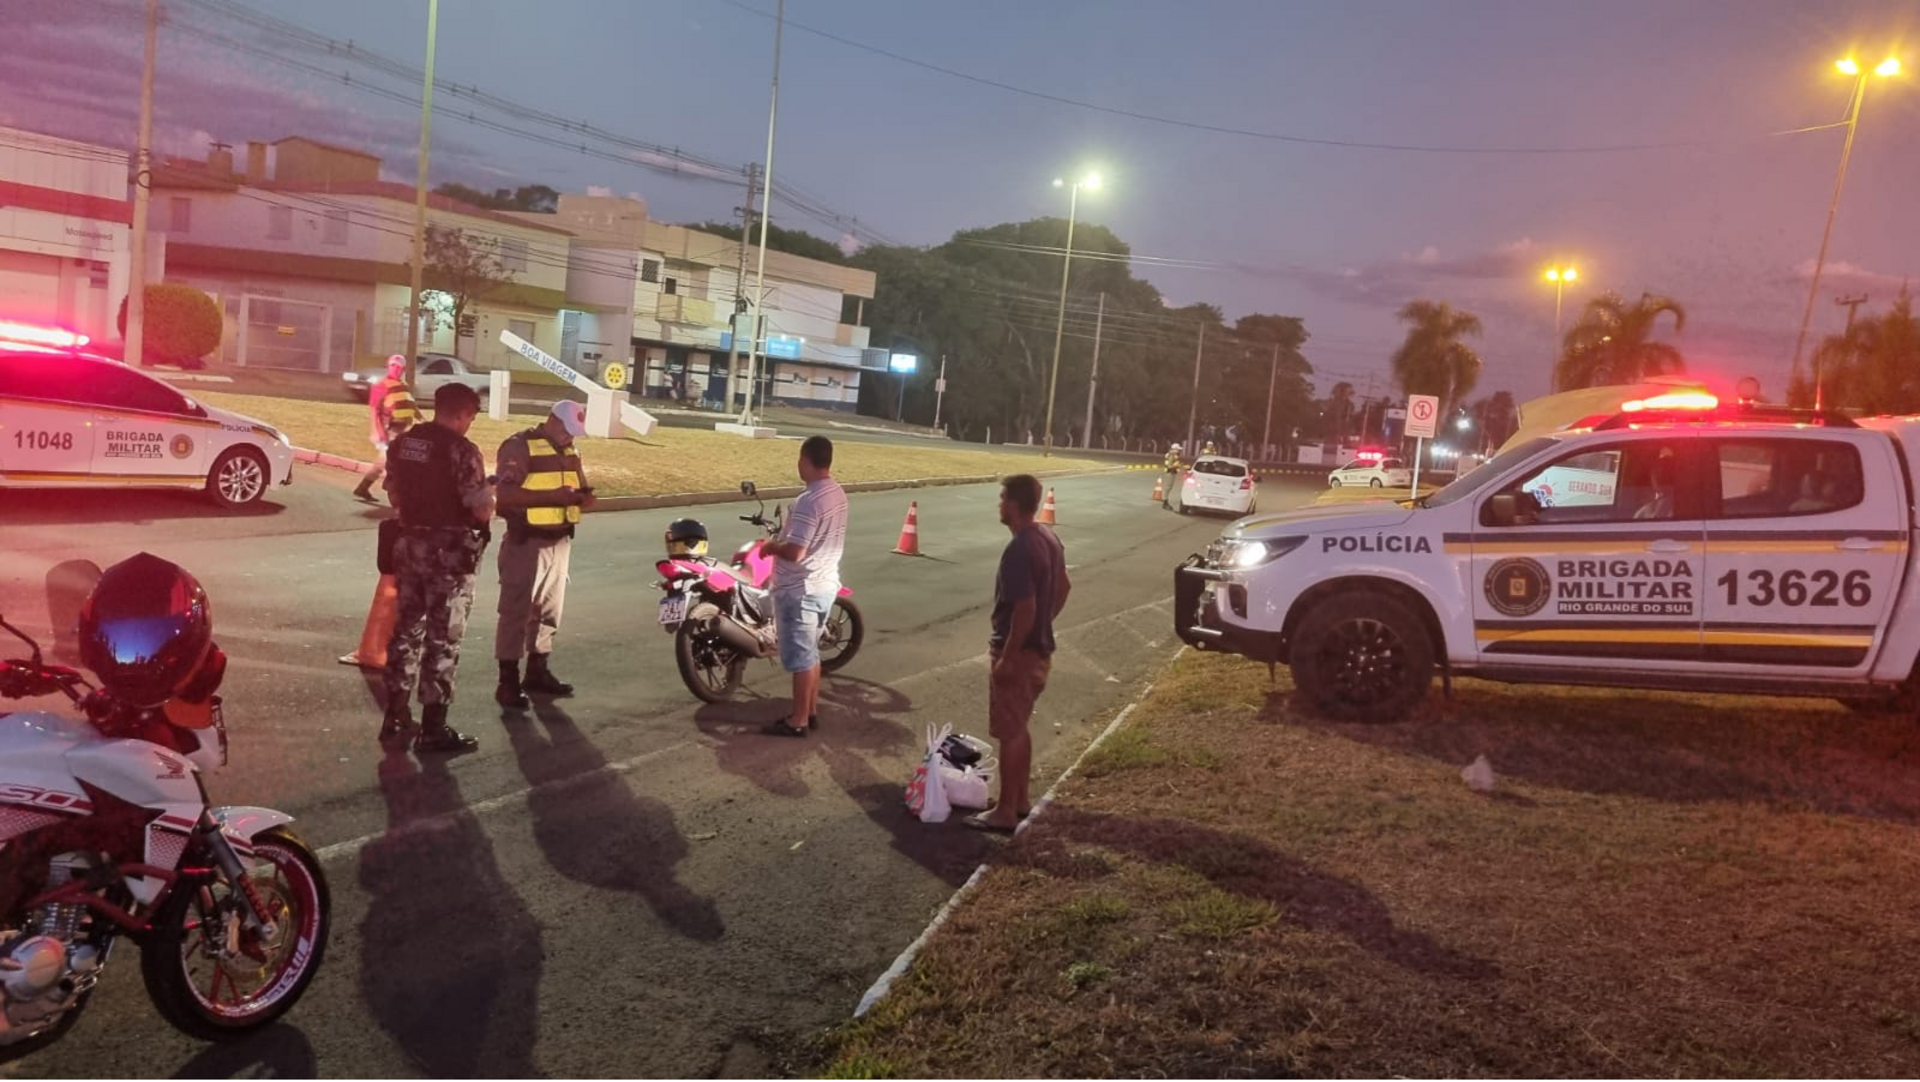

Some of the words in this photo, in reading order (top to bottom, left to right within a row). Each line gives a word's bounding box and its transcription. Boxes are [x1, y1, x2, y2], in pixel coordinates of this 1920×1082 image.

[520, 343, 541, 363] BOA
[542, 355, 578, 384] VIAGEM
[14, 430, 73, 450] 11048
[106, 431, 164, 442] BRIGADA
[108, 442, 161, 453] MILITAR
[1322, 531, 1433, 554] POLÍCIA
[1557, 560, 1693, 578] BRIGADA
[1557, 581, 1693, 598] MILITAR
[1717, 569, 1872, 607] 13626
[1559, 603, 1579, 612] RIO
[1584, 603, 1639, 613] GRANDE
[1642, 604, 1661, 613] DO
[1665, 604, 1691, 613] SUL
